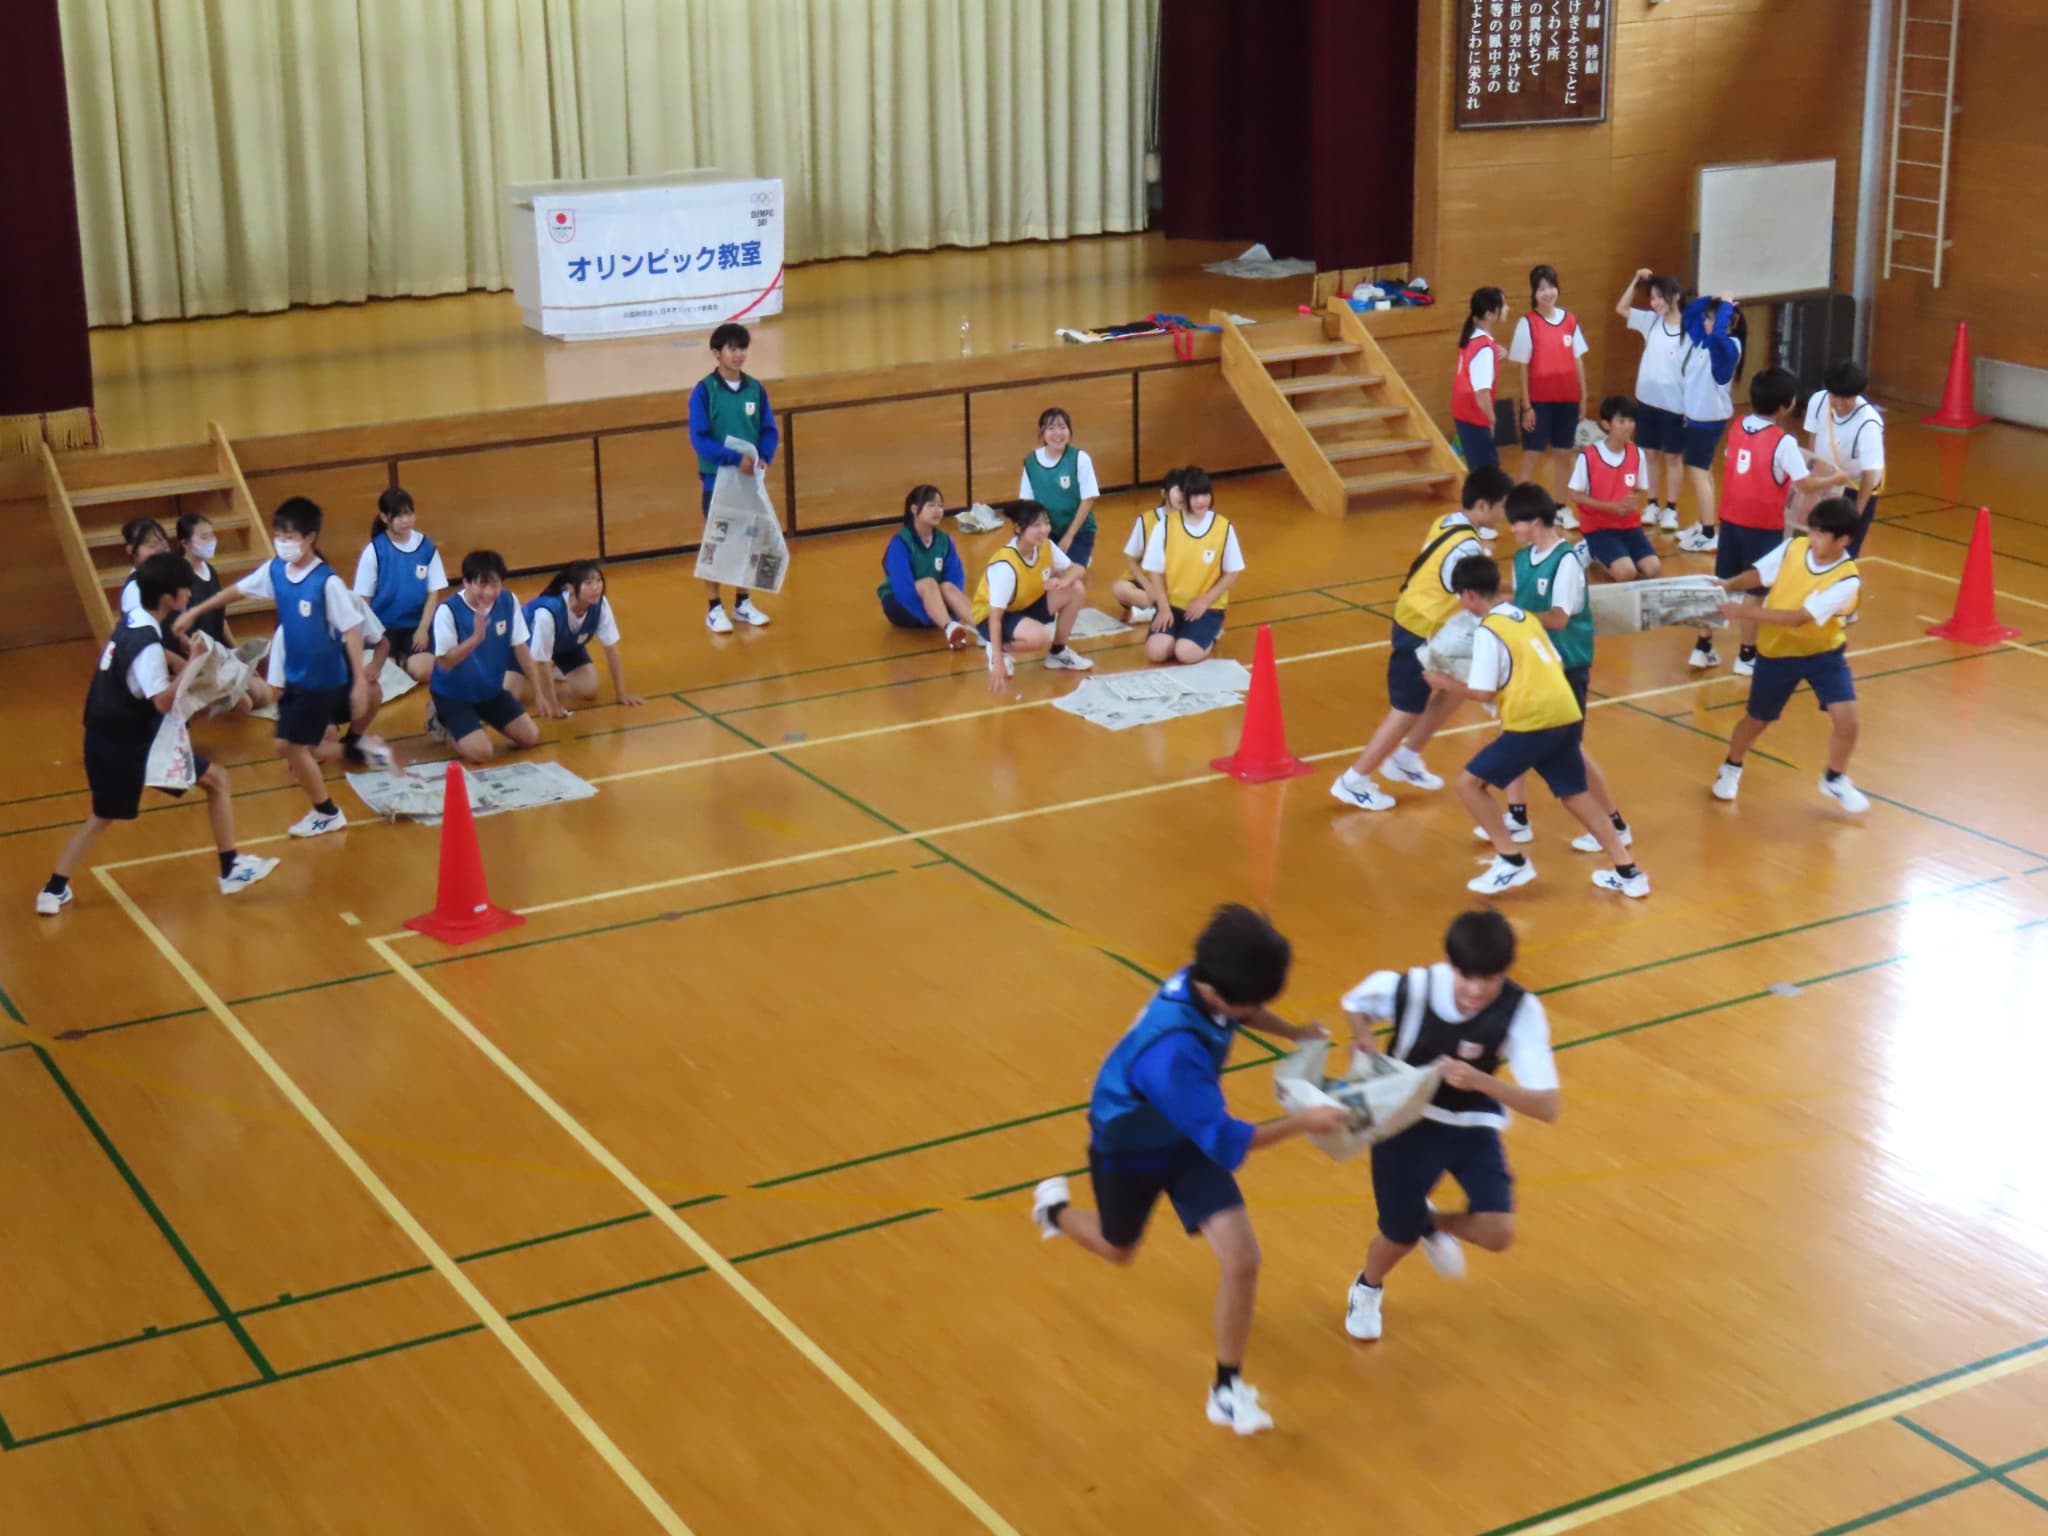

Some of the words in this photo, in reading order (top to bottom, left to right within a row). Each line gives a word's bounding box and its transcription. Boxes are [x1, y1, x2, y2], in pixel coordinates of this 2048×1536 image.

[1466, 0, 1483, 110] よとわに栄あれ
[1487, 0, 1504, 93] 等の鳳中学の
[1507, 0, 1522, 93] 世の空かけむ
[567, 240, 762, 282] オリンピック教室
